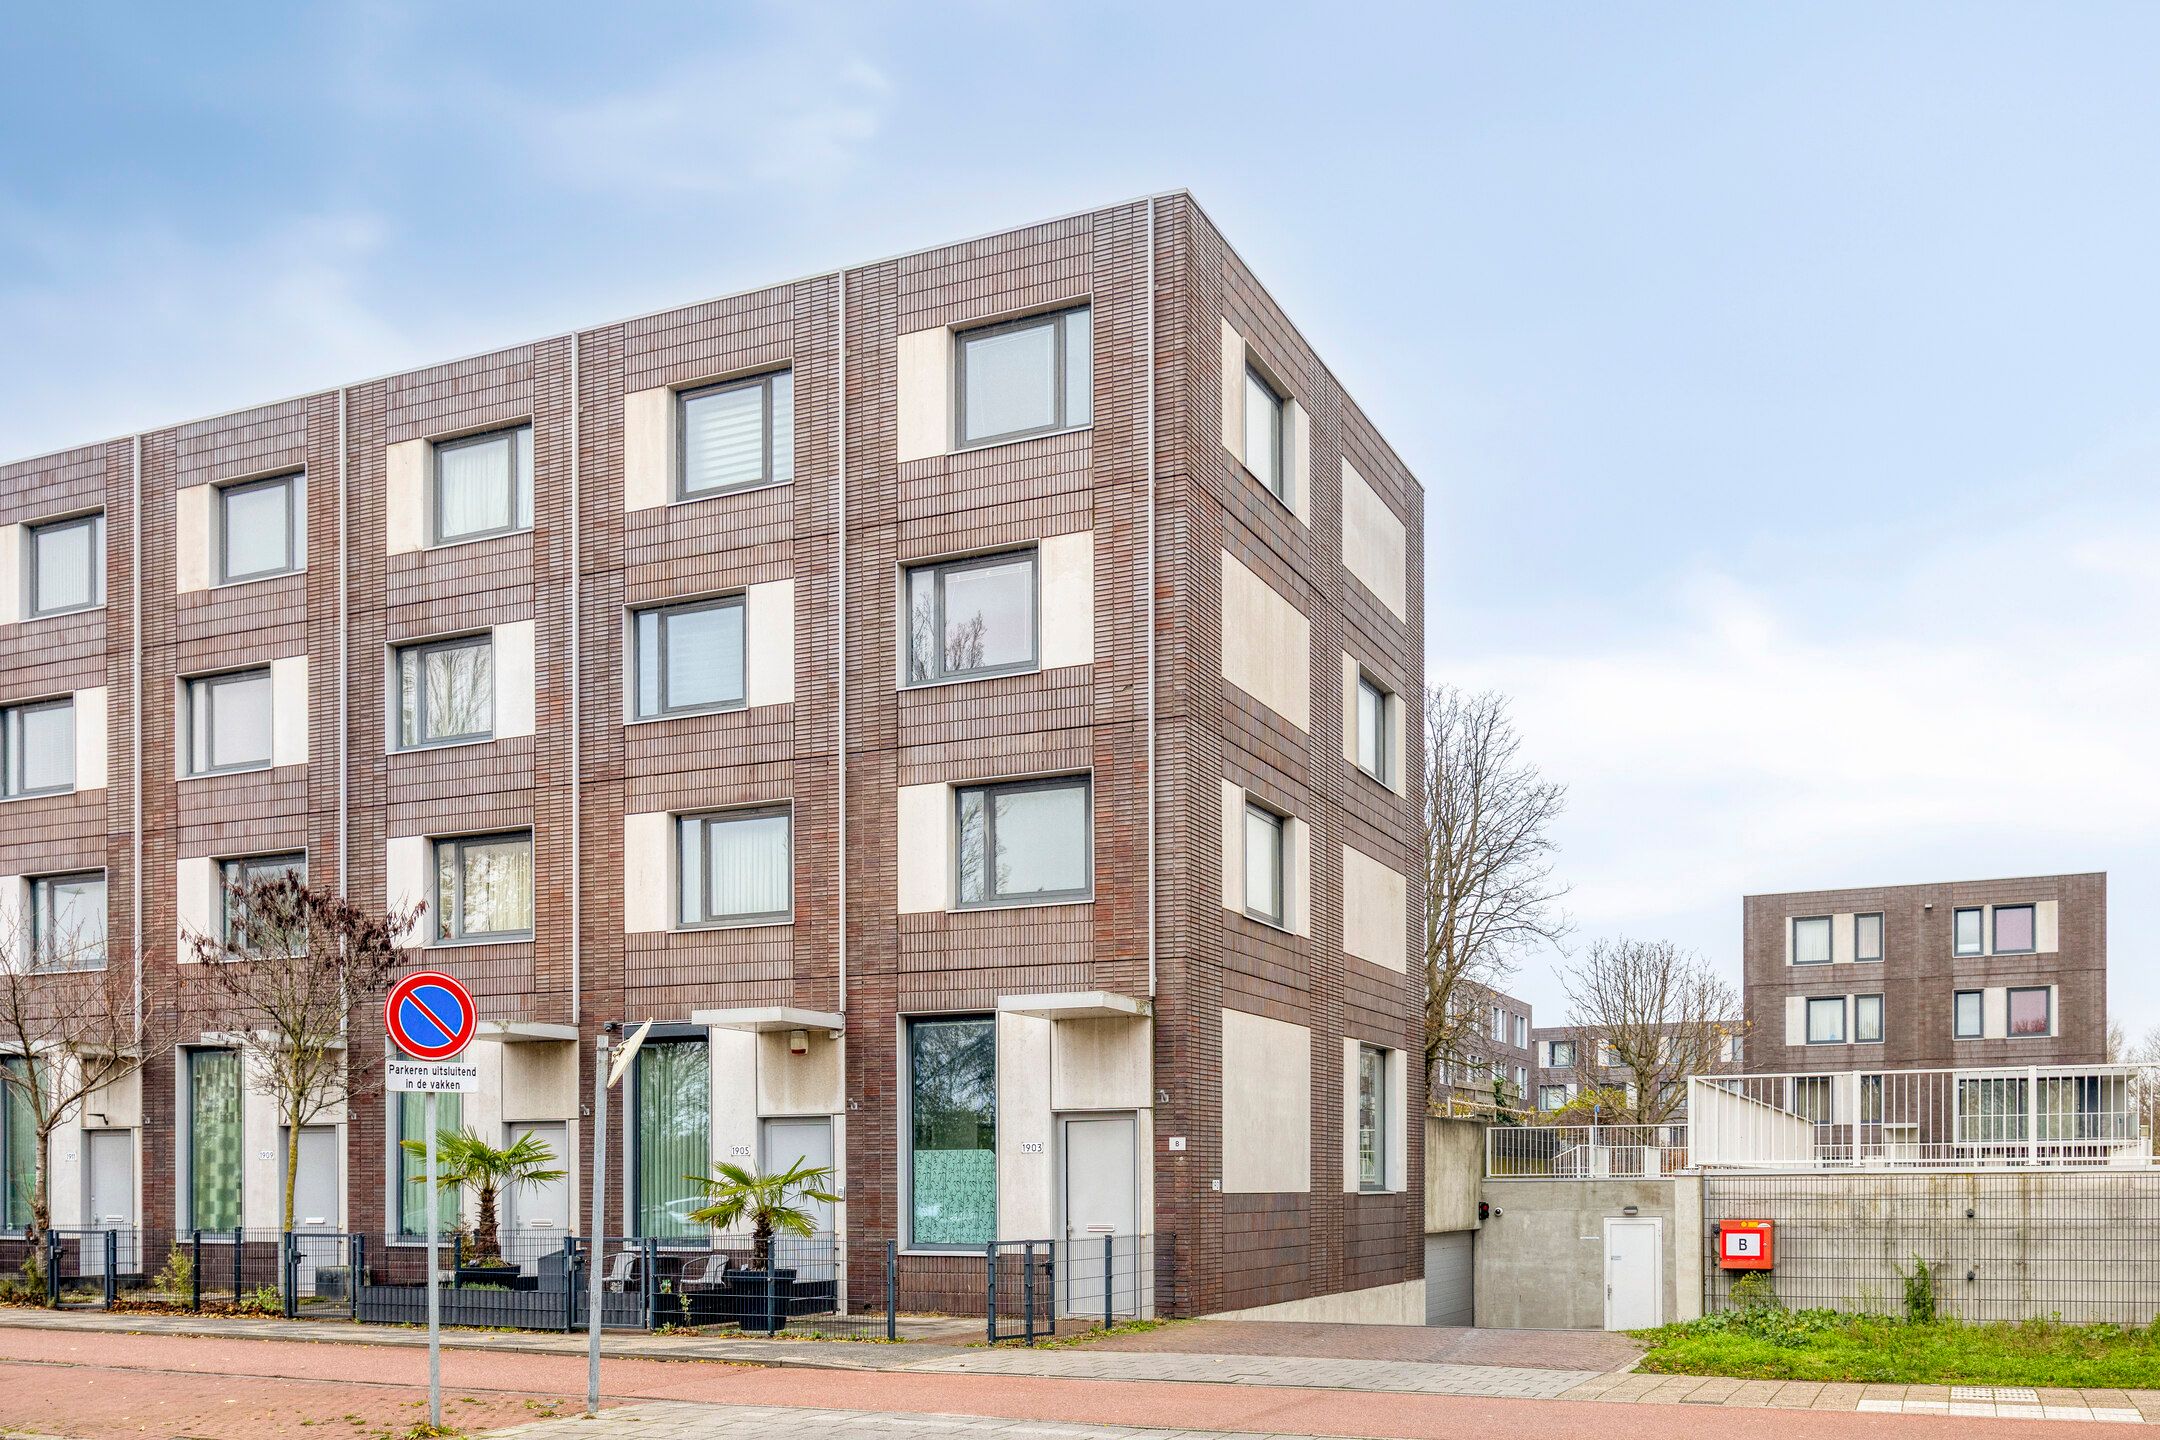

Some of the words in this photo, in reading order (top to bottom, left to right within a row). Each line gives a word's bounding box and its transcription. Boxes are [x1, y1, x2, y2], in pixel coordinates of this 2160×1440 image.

[389, 1064, 428, 1075] Parkeren
[432, 1066, 476, 1077] uitsluitend
[406, 1079, 413, 1088] in
[417, 1079, 427, 1089] de
[430, 1080, 460, 1090] vakken
[732, 1146, 749, 1155] 1905
[1022, 1143, 1042, 1152] 1903
[259, 1151, 274, 1159] 1909
[1738, 1238, 1748, 1251] B
